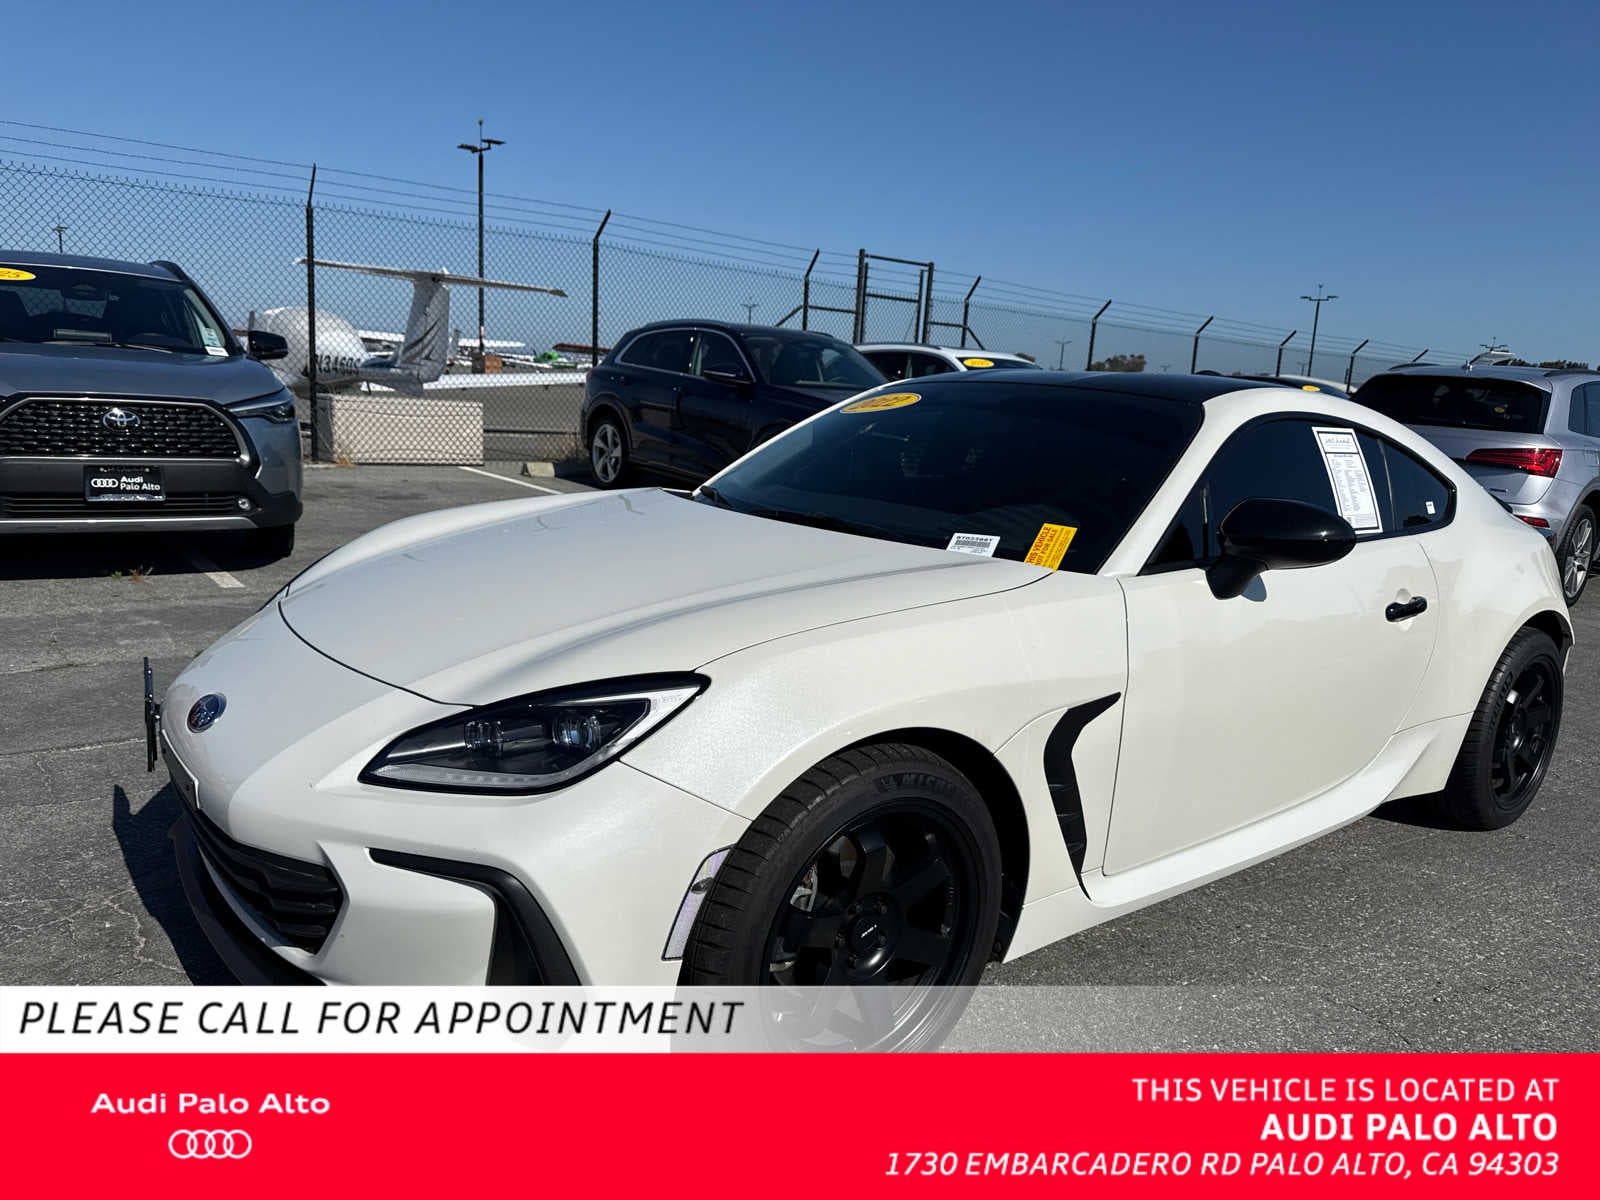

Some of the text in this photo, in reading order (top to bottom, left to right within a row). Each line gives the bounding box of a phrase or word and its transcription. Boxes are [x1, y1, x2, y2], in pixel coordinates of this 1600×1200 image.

[120, 476, 143, 484] Audi
[120, 483, 161, 491] Palo Alto
[1034, 526, 1050, 551] VEHICLE
